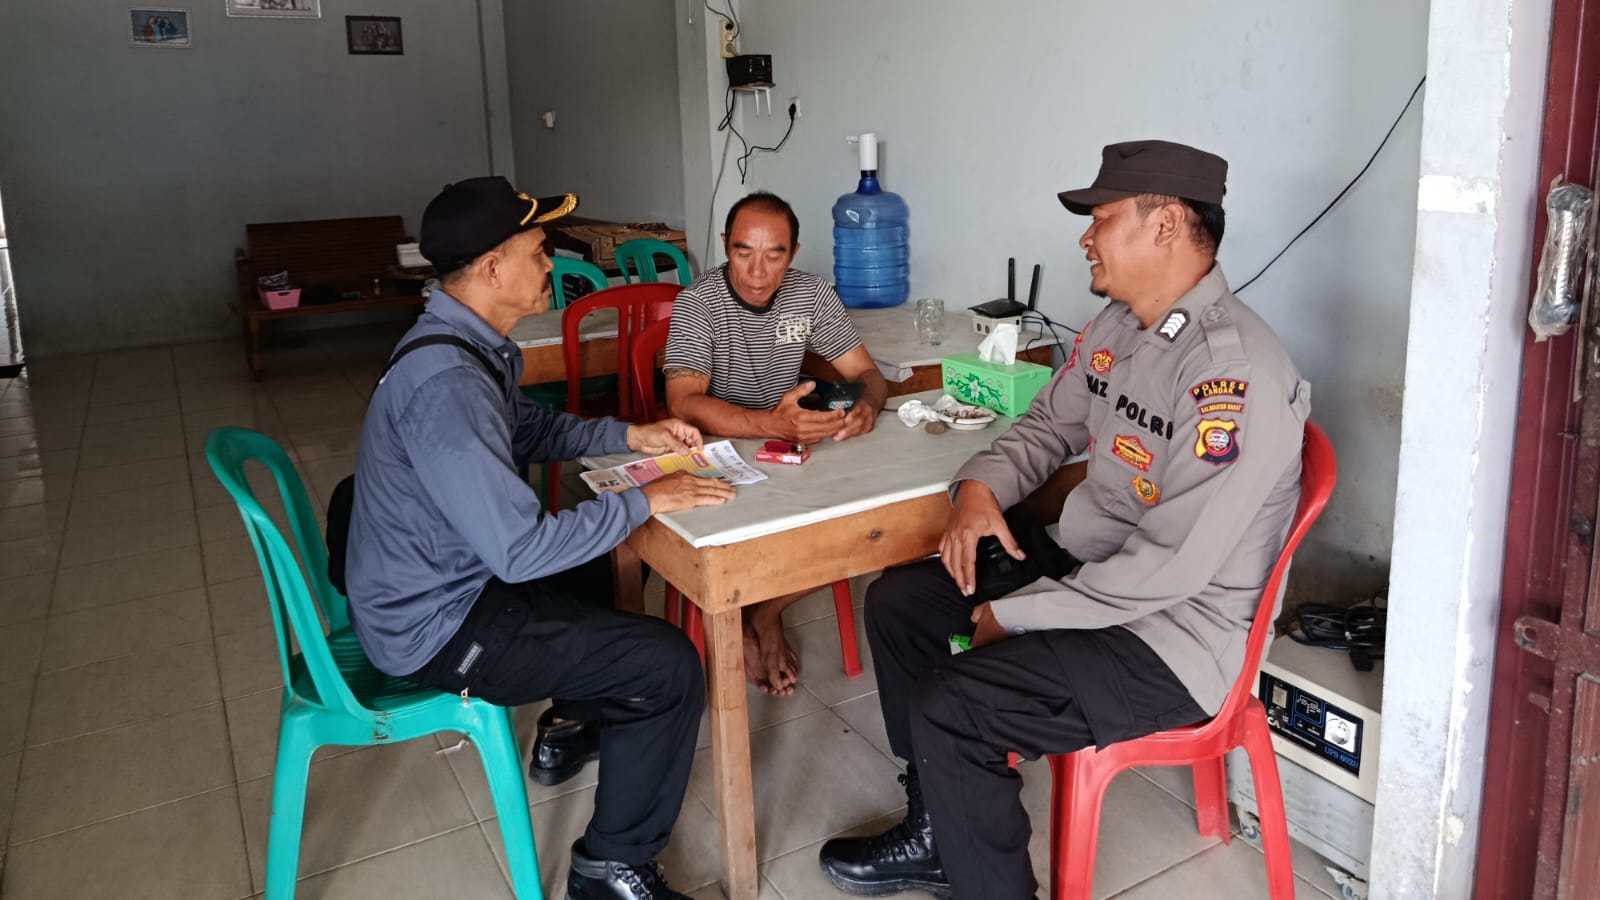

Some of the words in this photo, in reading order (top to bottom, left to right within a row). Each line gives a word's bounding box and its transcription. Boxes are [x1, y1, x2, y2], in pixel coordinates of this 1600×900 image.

[1193, 381, 1245, 396] POLRES
[1203, 387, 1233, 396] LANDAK
[1116, 394, 1173, 440] POLRI
